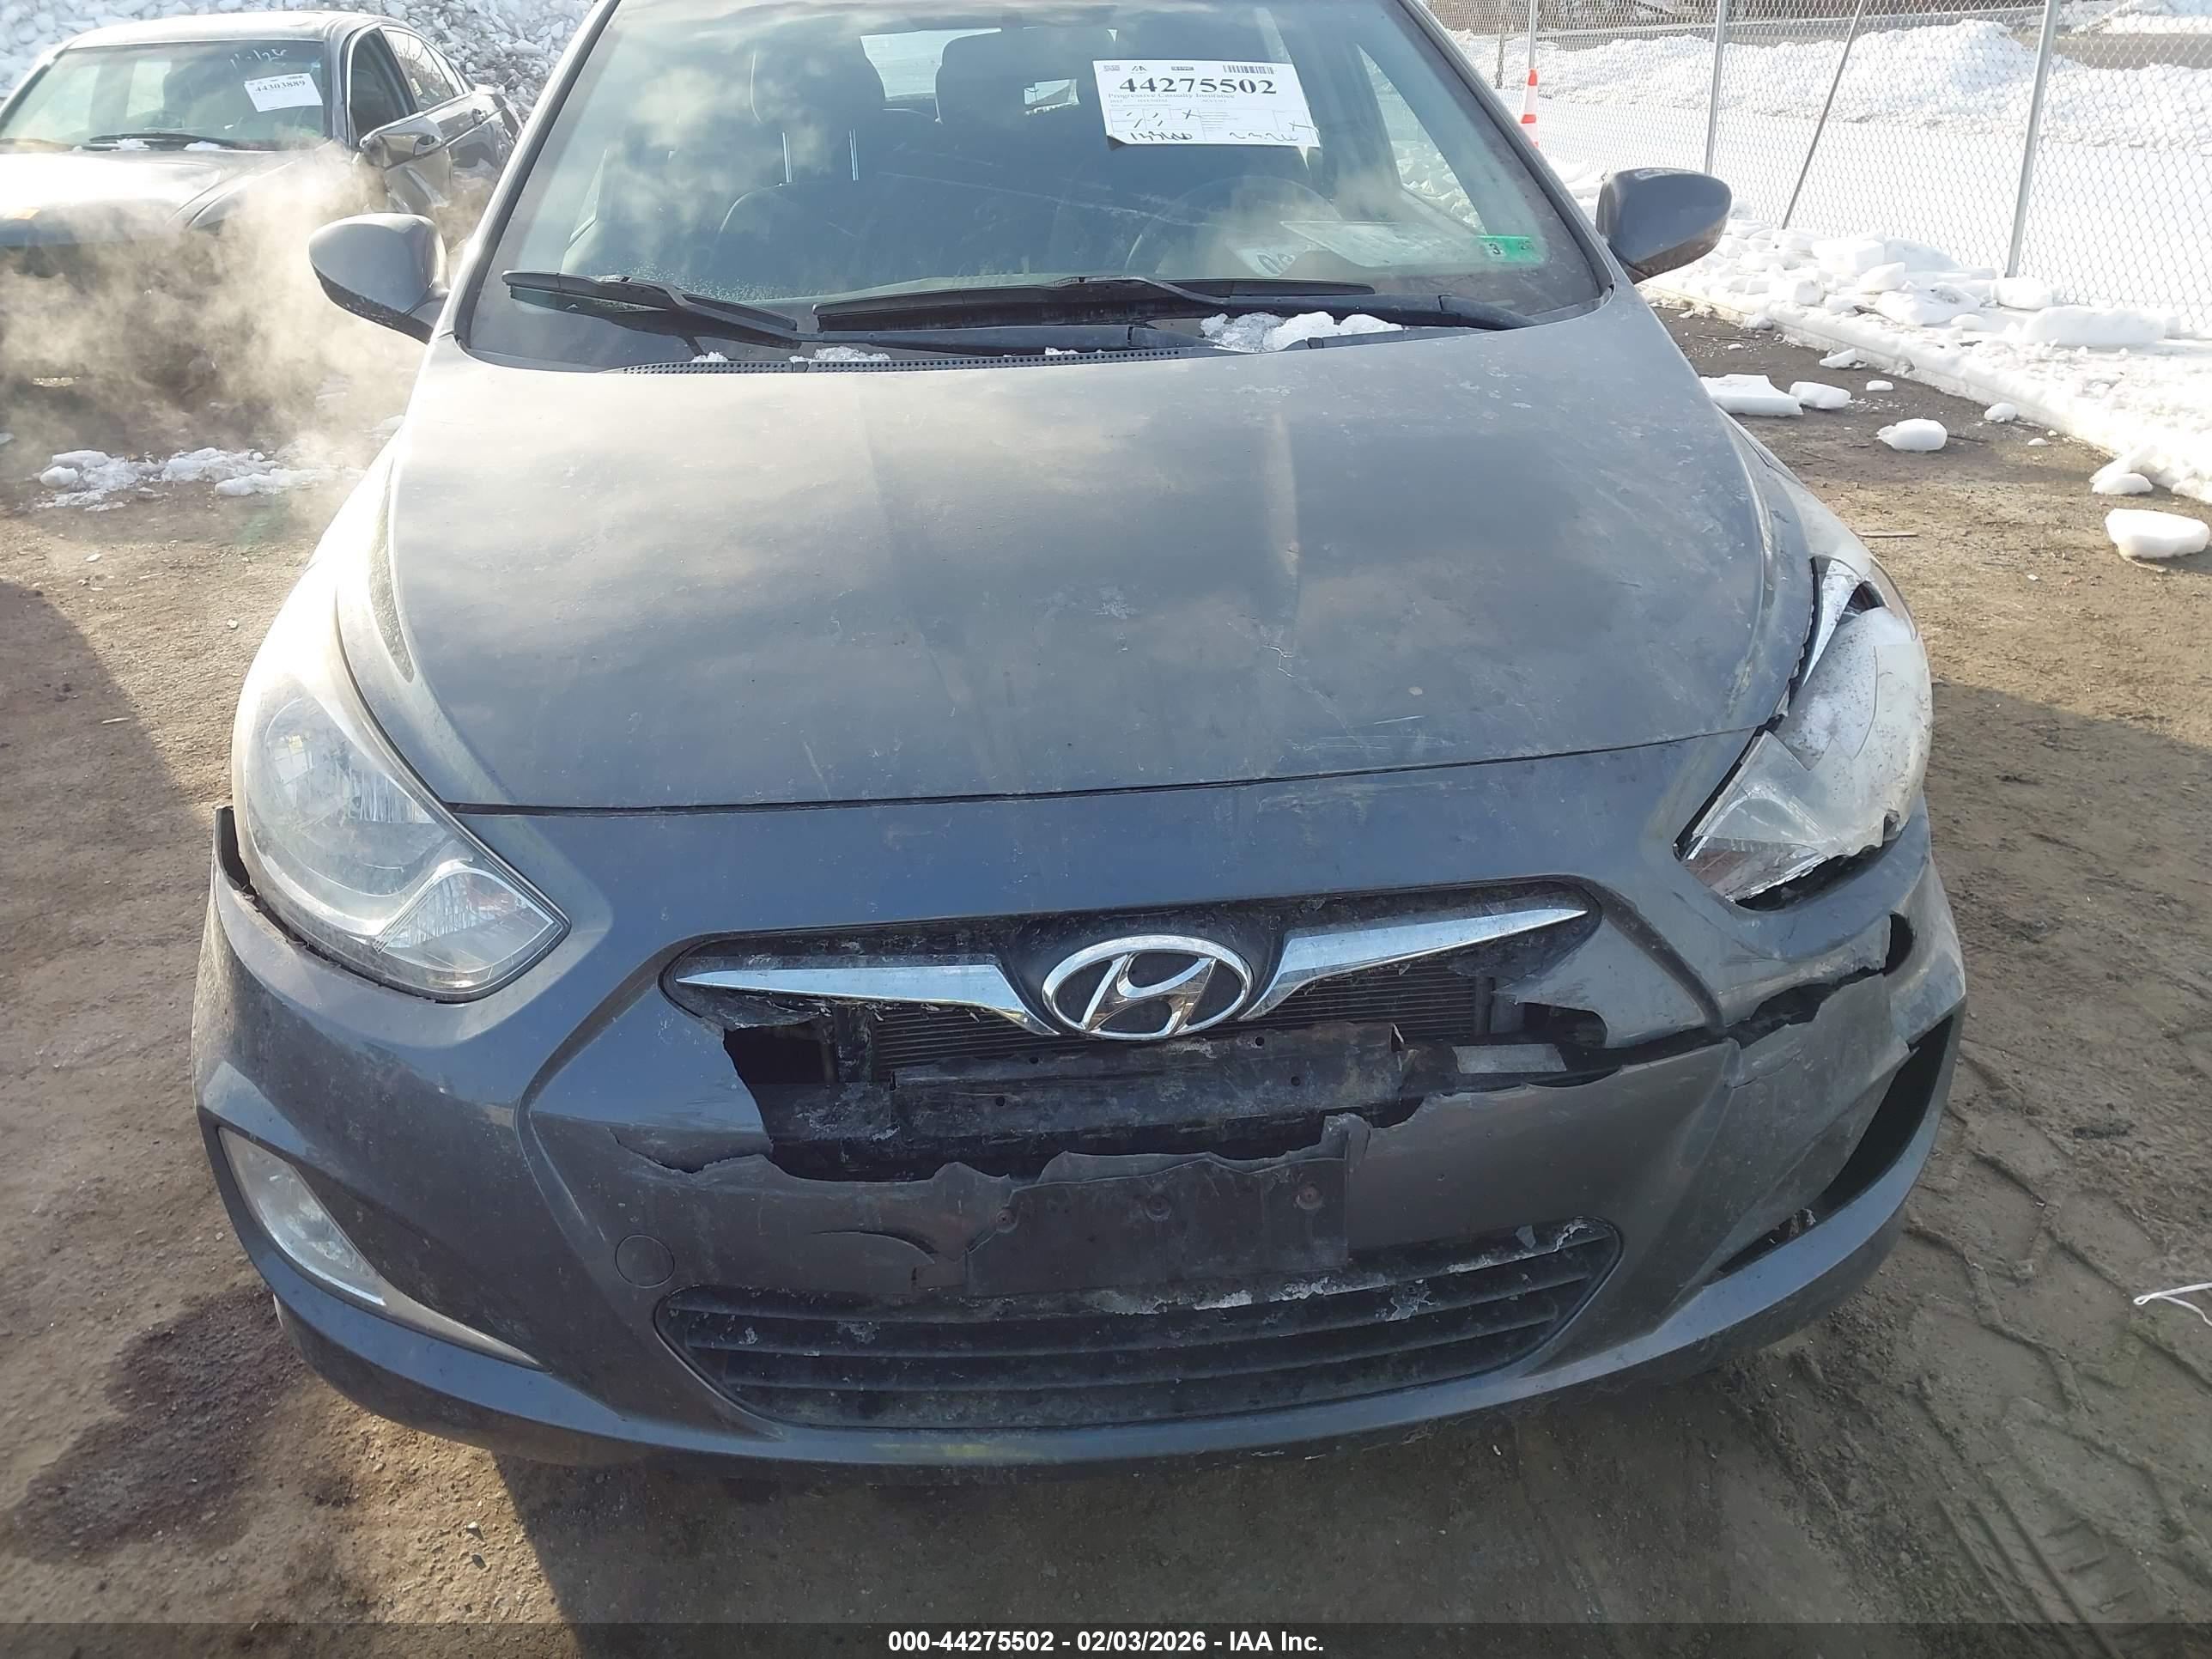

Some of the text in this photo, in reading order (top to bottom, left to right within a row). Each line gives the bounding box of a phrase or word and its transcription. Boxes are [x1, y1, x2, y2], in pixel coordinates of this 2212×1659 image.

[255, 80, 306, 92] 44303889
[1119, 77, 1277, 94] 44275502
[1489, 243, 1501, 255] 3
